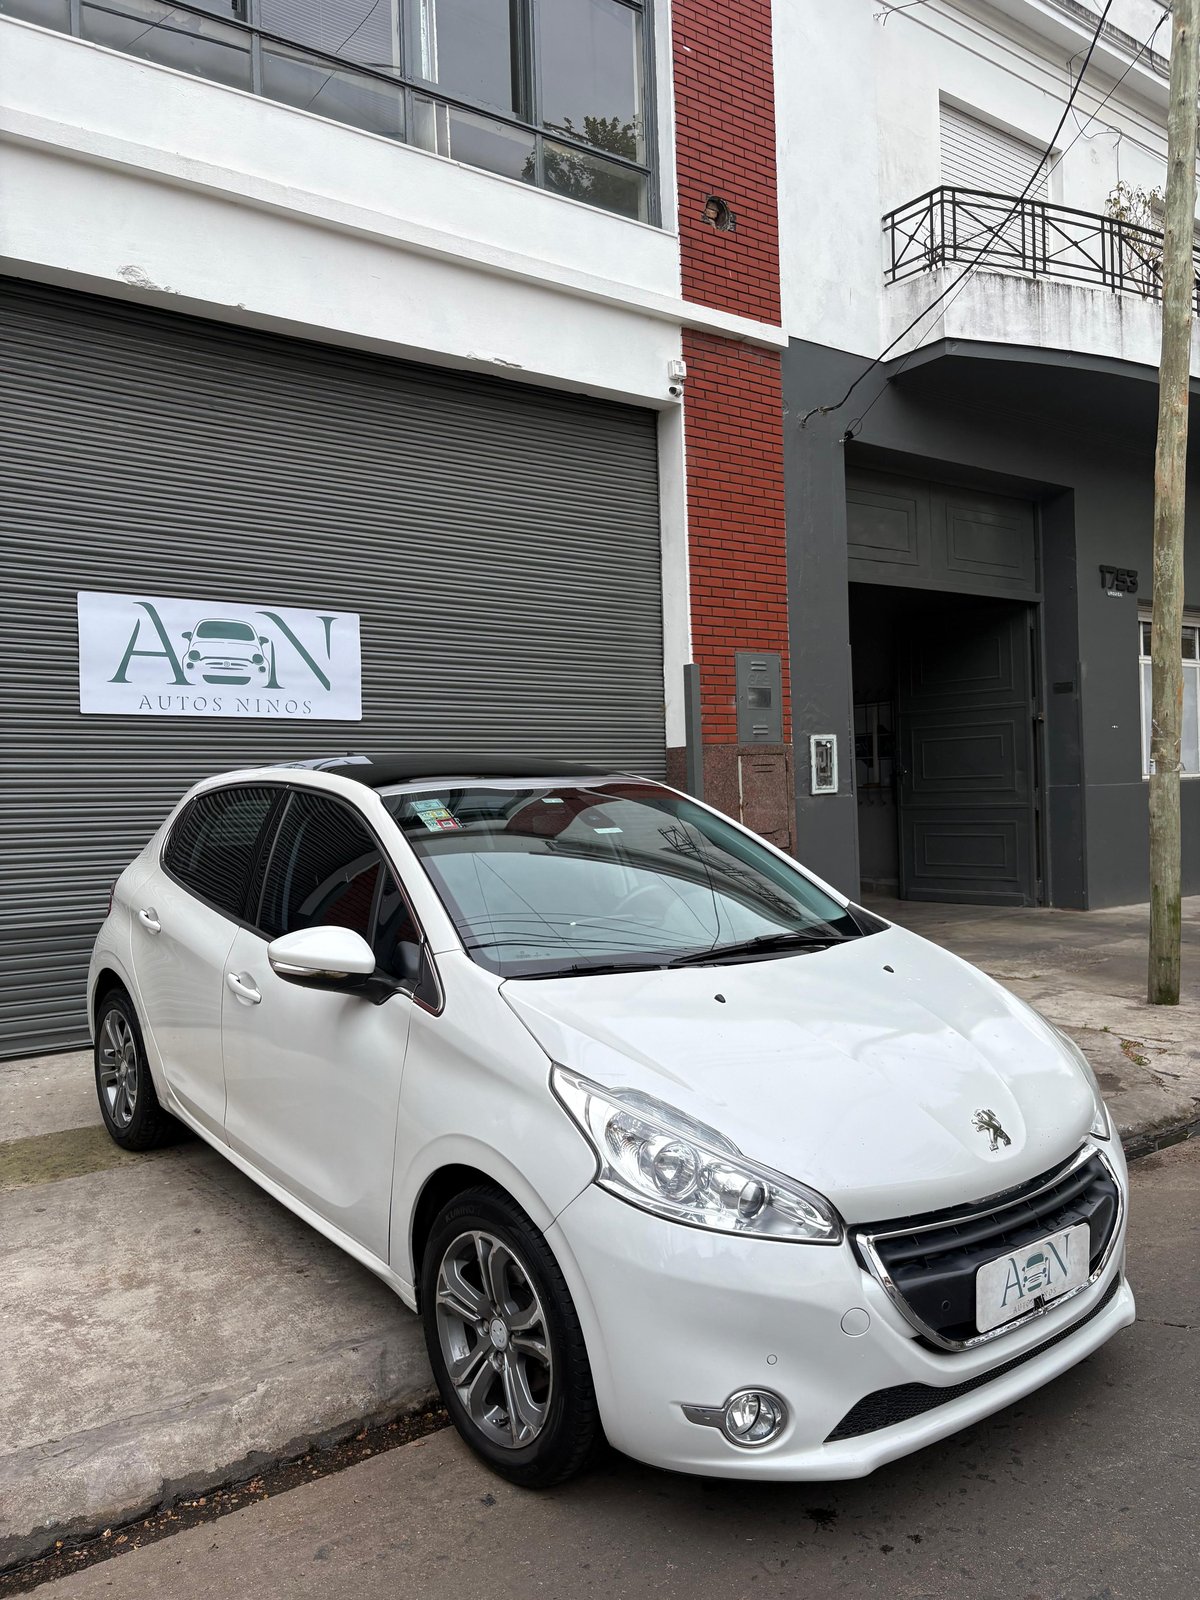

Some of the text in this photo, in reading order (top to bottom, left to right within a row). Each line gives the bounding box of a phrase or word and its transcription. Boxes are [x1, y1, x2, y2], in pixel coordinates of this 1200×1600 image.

[1099, 565, 1138, 593] 1753
[138, 695, 312, 714] AUTOS NINOS
